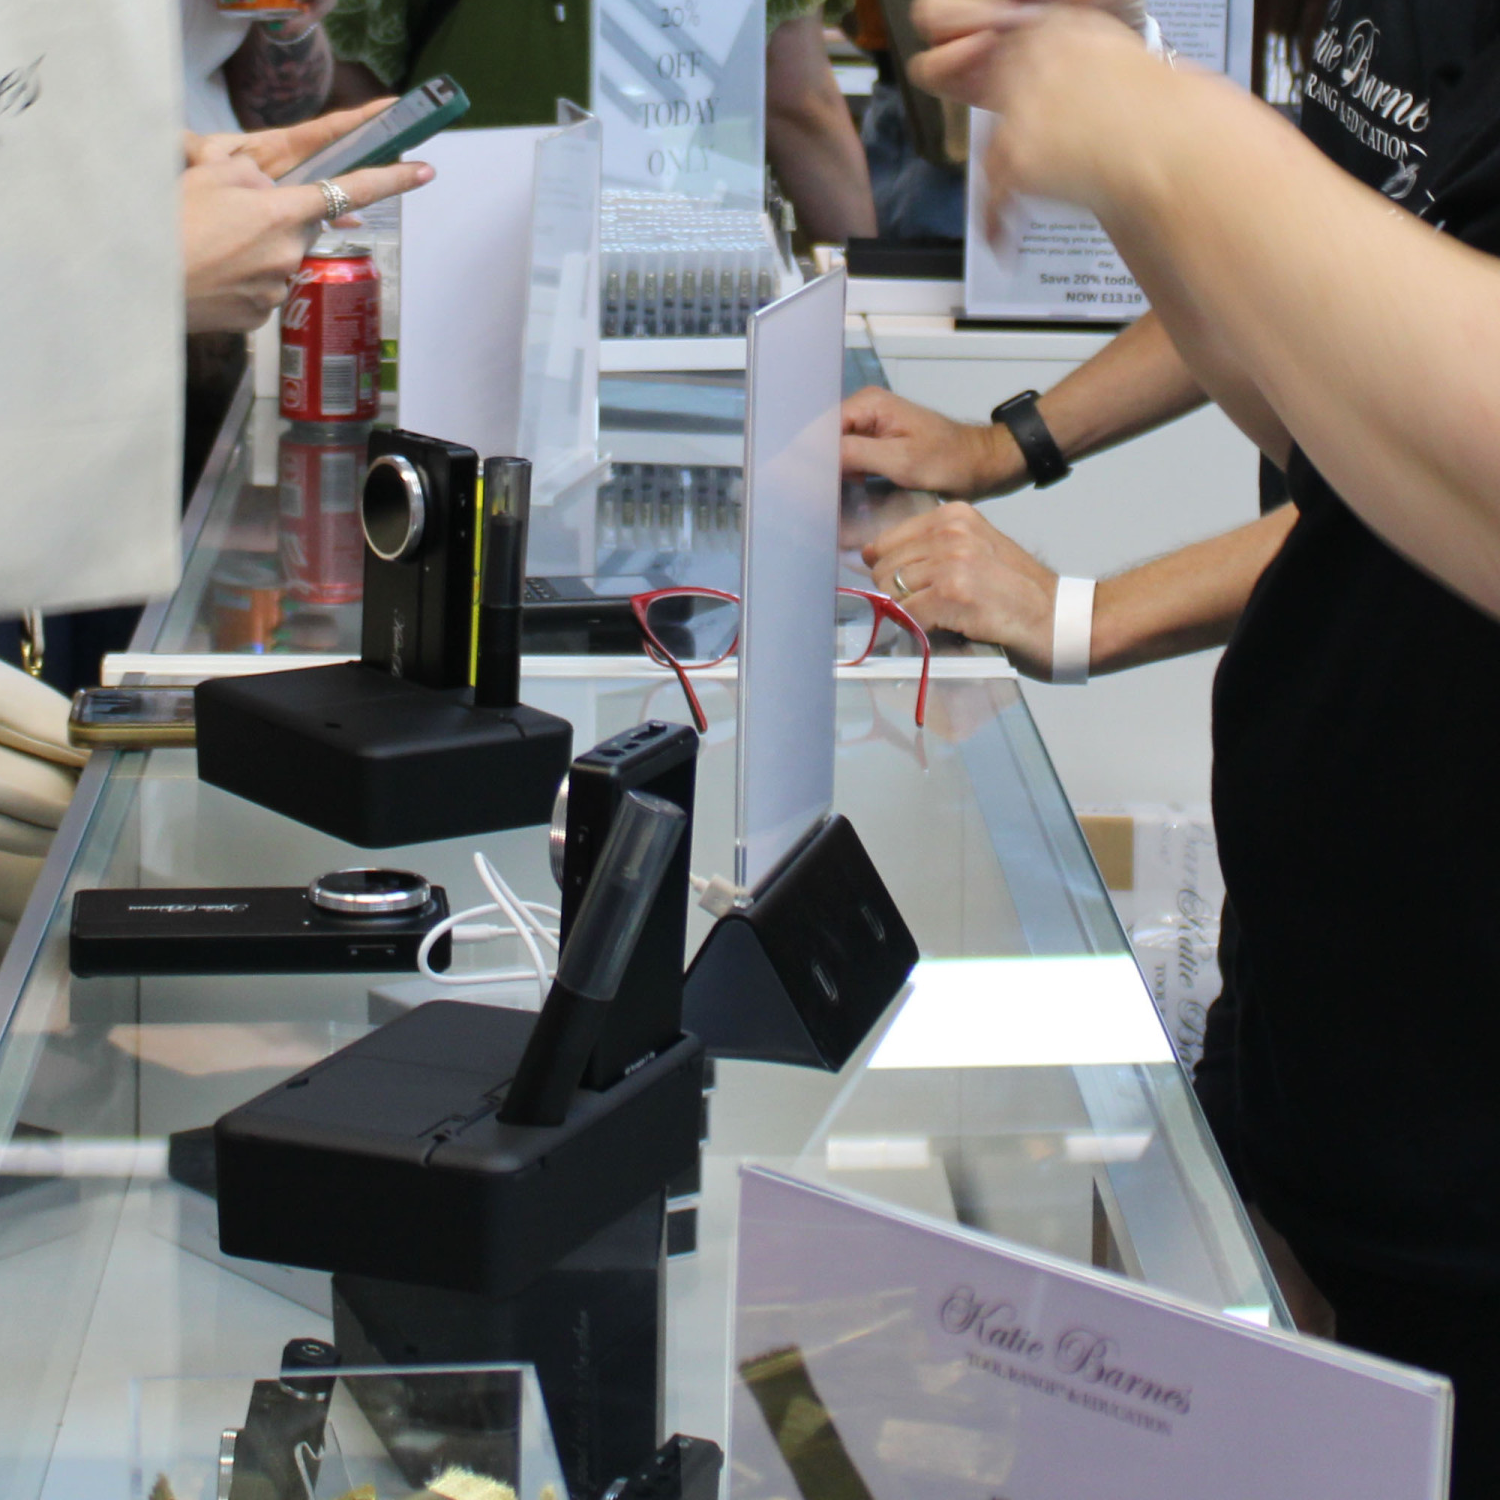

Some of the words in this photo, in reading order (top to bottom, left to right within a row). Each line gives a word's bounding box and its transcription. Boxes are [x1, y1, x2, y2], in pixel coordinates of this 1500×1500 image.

[659, 0, 700, 29] 20%
[656, 51, 703, 80] OFF
[638, 97, 721, 130] TODAY
[647, 143, 716, 177] ONLY
[1040, 273, 1070, 285] Save
[1073, 274, 1100, 285] 20%
[1065, 292, 1099, 304] NOW
[940, 1284, 1045, 1362] Katie
[1054, 1327, 1193, 1416] Barnes
